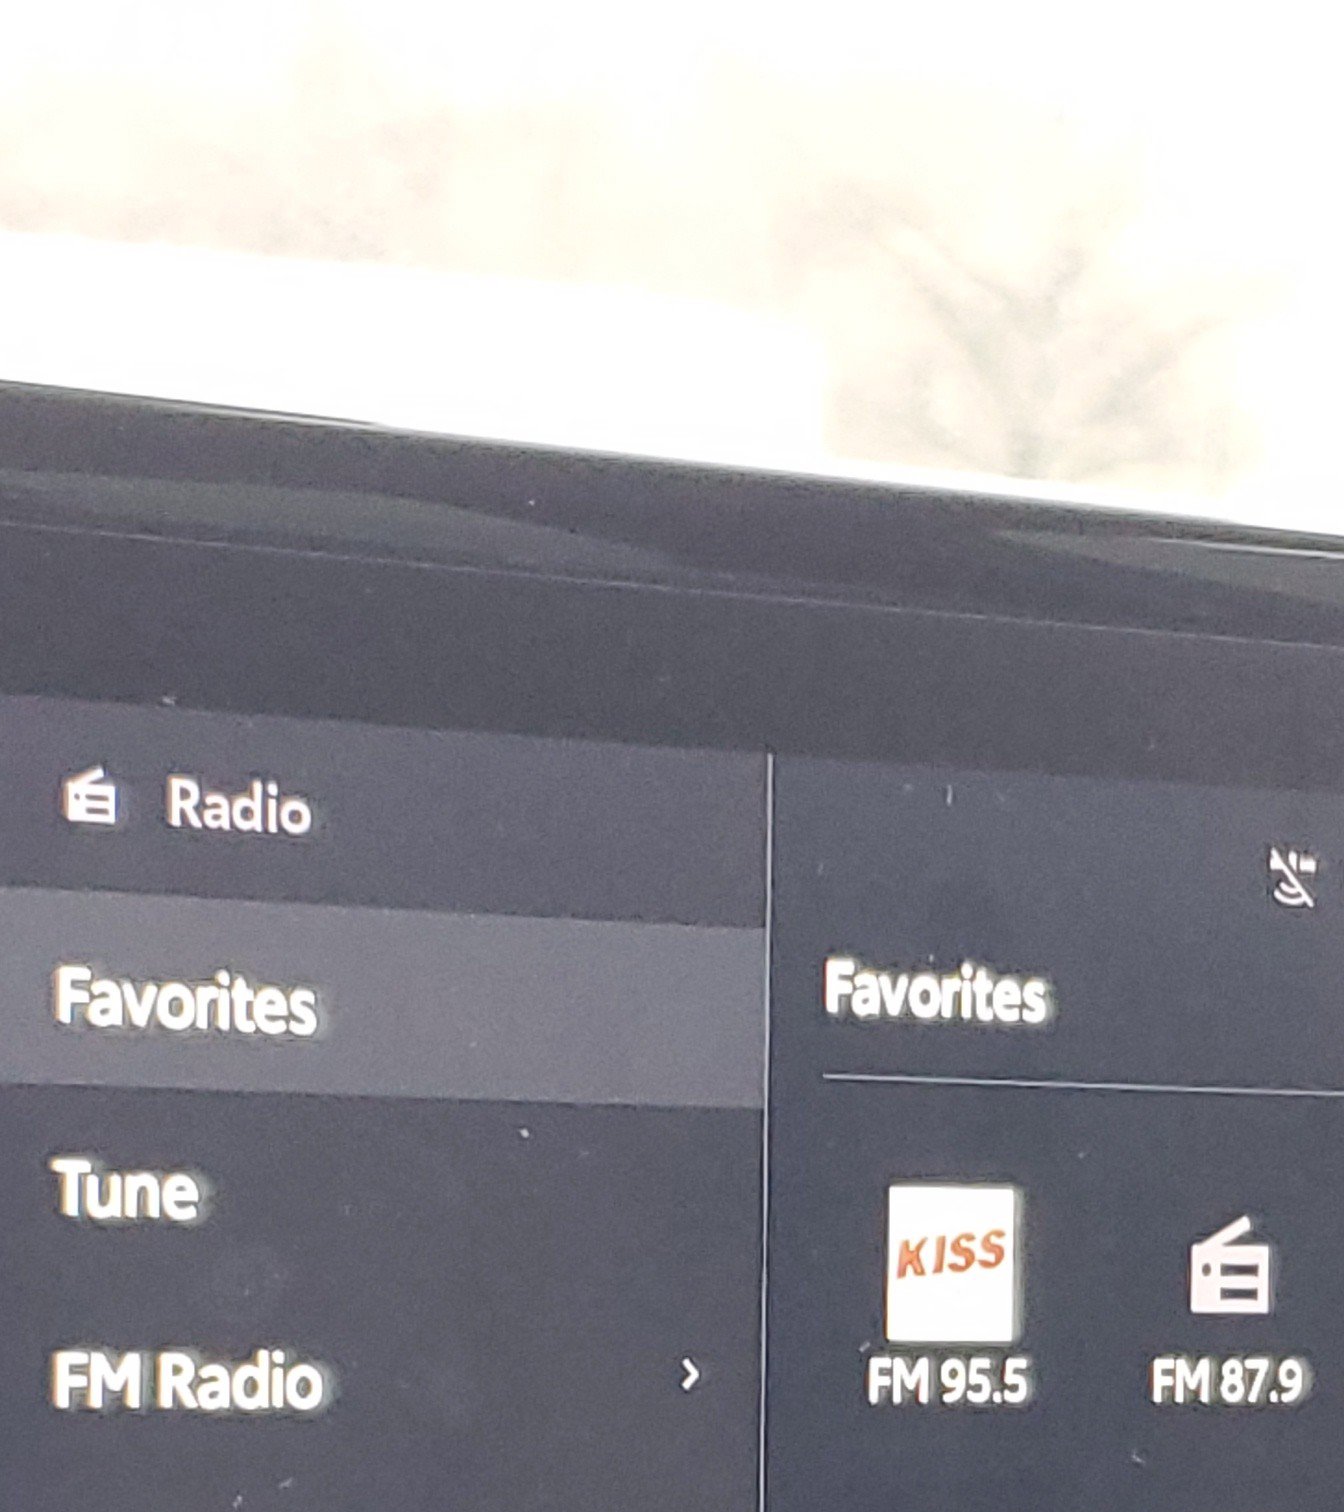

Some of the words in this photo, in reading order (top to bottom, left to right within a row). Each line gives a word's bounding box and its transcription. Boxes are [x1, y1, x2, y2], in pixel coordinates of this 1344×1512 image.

[169, 776, 312, 835] Radio
[56, 964, 319, 1037] Favorites
[824, 957, 1049, 1025] Favorites
[50, 1157, 201, 1222] Tune
[896, 1228, 1006, 1279] KISS
[54, 1350, 143, 1410] FM
[157, 1348, 325, 1412] Radio
[867, 1355, 931, 1405] FM
[939, 1356, 1030, 1405] 95.5
[1152, 1357, 1213, 1405] FM
[1218, 1357, 1305, 1405] 87.9
